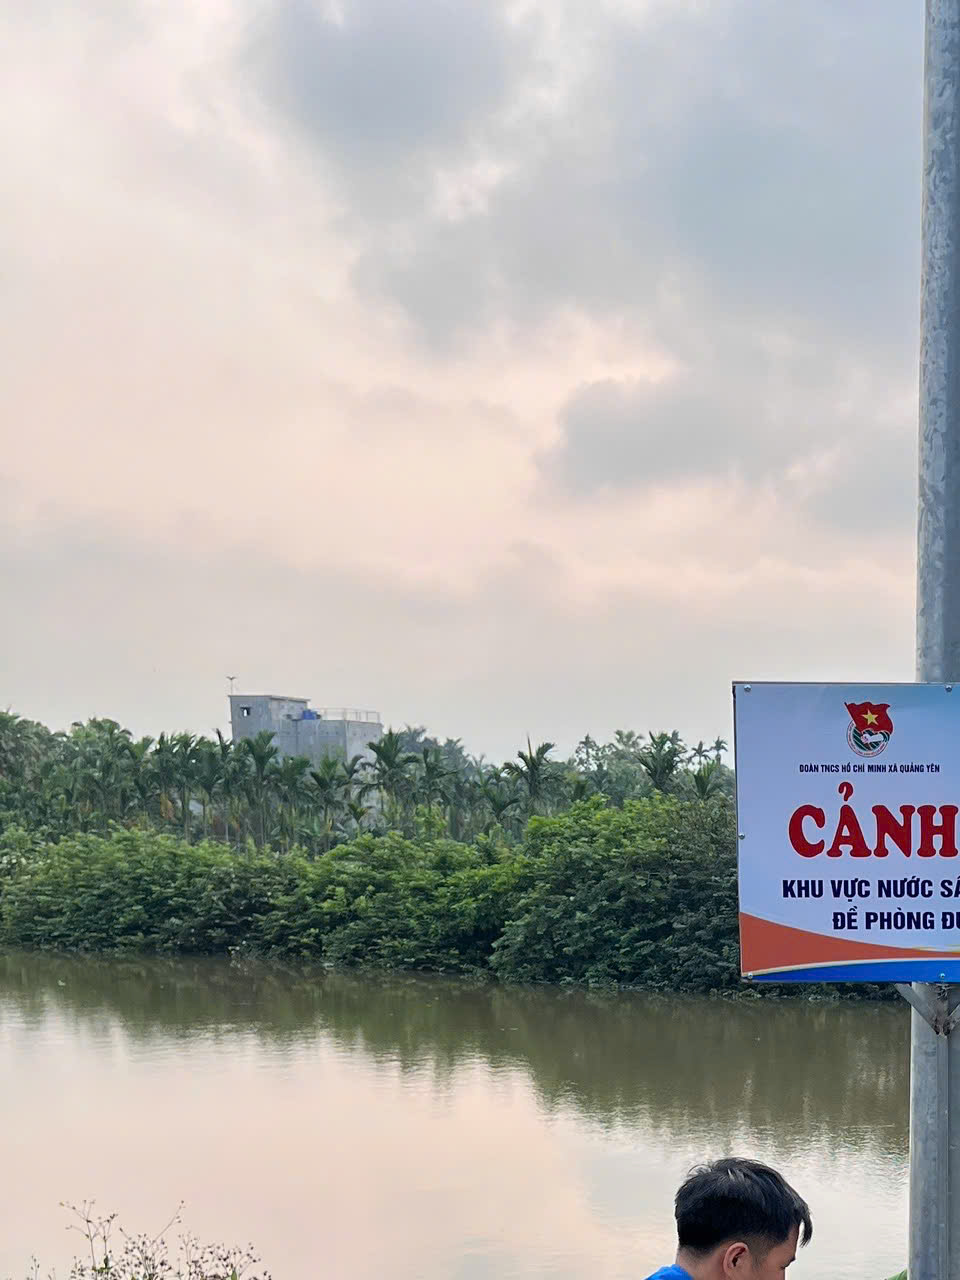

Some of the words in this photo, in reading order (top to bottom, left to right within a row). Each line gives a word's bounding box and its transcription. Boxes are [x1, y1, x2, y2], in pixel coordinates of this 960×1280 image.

[799, 762, 819, 773] ĐOÀN
[821, 764, 840, 773] TNCS
[853, 763, 865, 773] CHÍ
[867, 764, 887, 773] MINH
[899, 762, 925, 774] QUẢNG
[926, 762, 940, 773] YÊN
[788, 782, 958, 858] CẢNH
[782, 879, 824, 898] KHU
[830, 877, 871, 902] VỰC
[877, 875, 933, 898] NƯỚC
[832, 905, 859, 930] ĐỀ
[865, 907, 935, 930] PHÒNG
